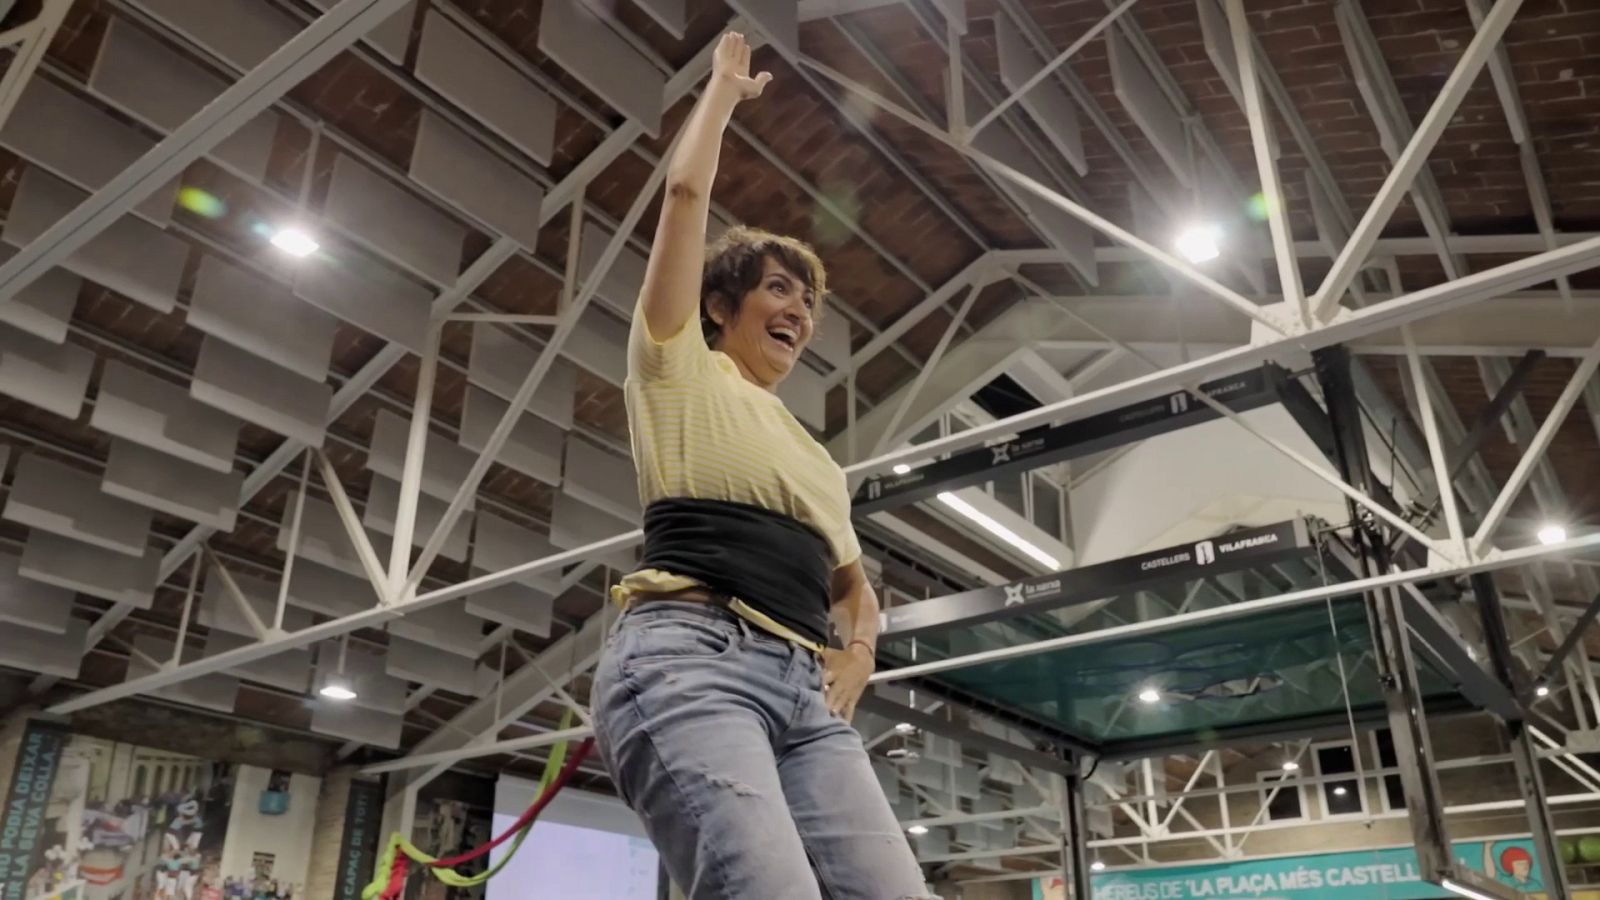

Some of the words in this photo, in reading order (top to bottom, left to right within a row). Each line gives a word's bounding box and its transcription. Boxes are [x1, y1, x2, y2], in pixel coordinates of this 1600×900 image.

[1141, 552, 1190, 571] CASTELLERS
[1, 799, 26, 849] PODIA
[15, 732, 42, 794] DEIXAR
[19, 807, 41, 850] SEVA
[12, 854, 30, 877] LA
[1160, 880, 1184, 899] DE
[1216, 873, 1278, 896] PLAÇA
[1279, 865, 1323, 890] MÉS
[1326, 862, 1422, 887] CASTELL
